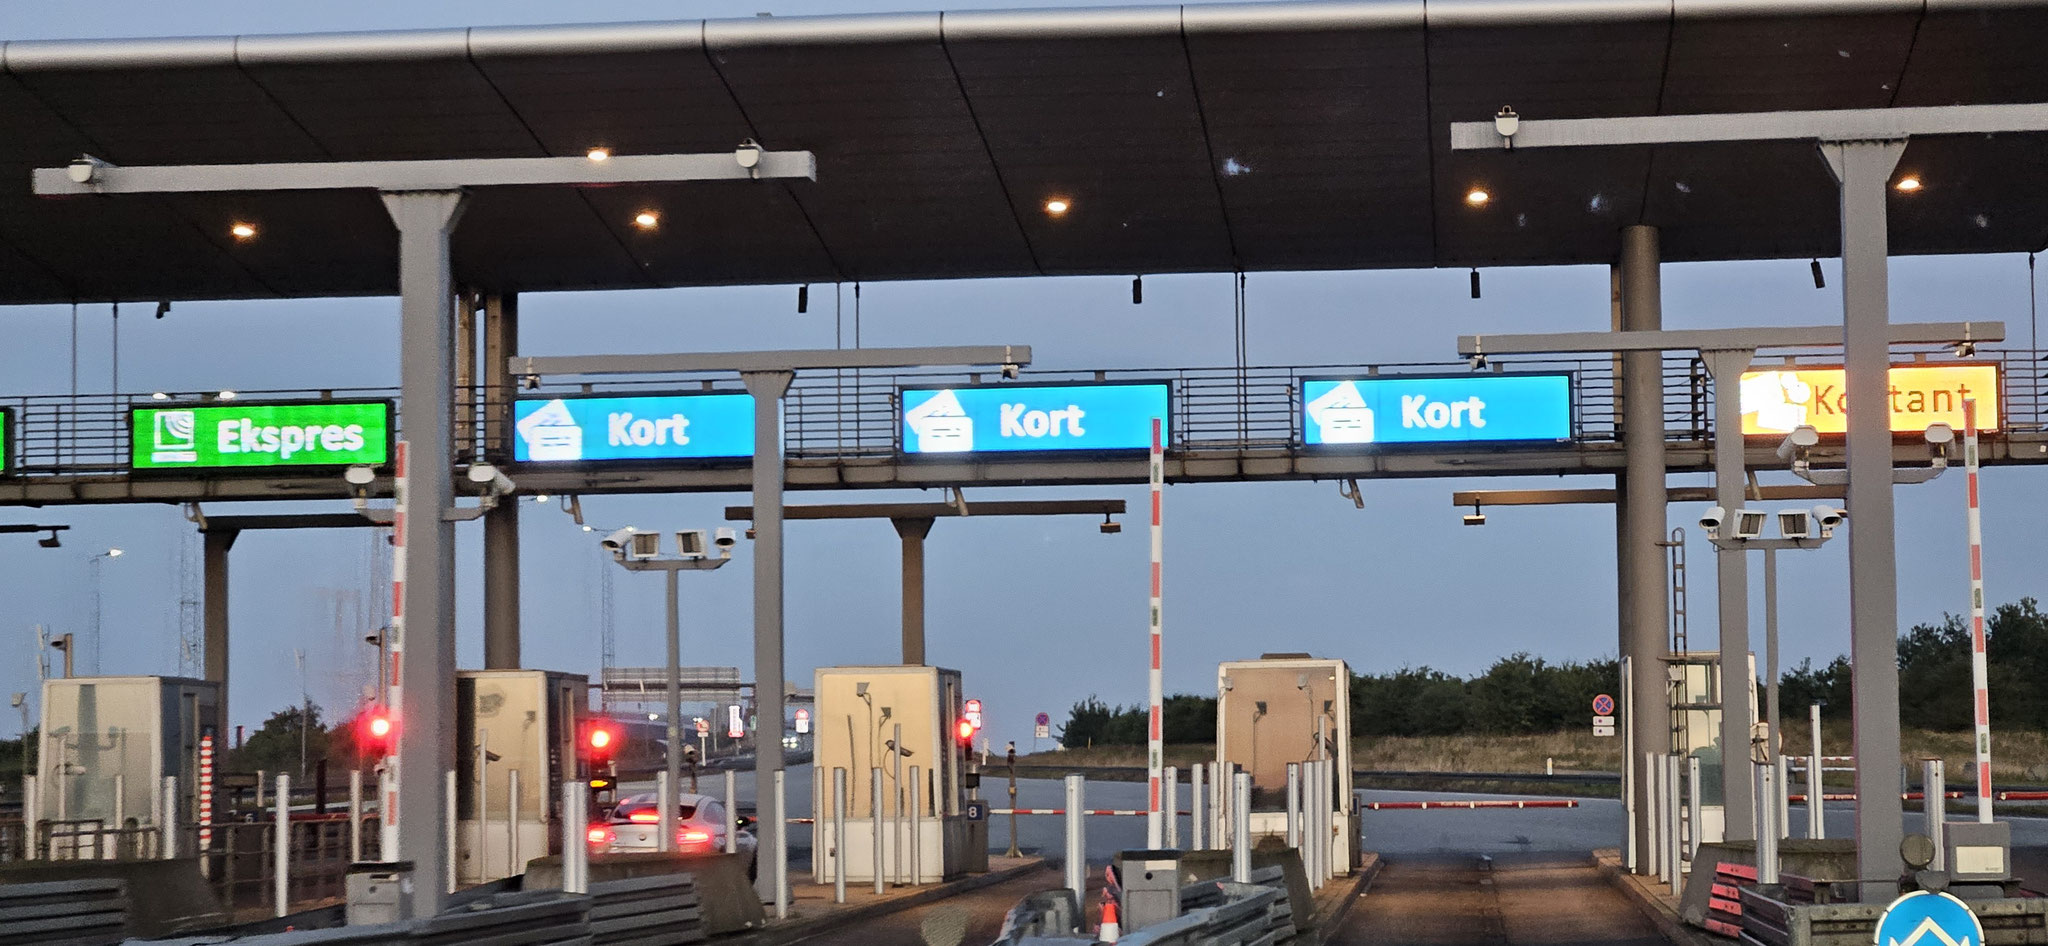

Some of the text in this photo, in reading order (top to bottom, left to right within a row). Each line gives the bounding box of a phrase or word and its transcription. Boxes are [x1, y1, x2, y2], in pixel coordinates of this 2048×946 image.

[1401, 395, 1486, 428] Kort
[1815, 383, 1971, 415] Kotant
[608, 412, 690, 446] Kort
[1000, 403, 1085, 437] Kort
[218, 418, 364, 459] Ekspres
[968, 806, 978, 819] 8
